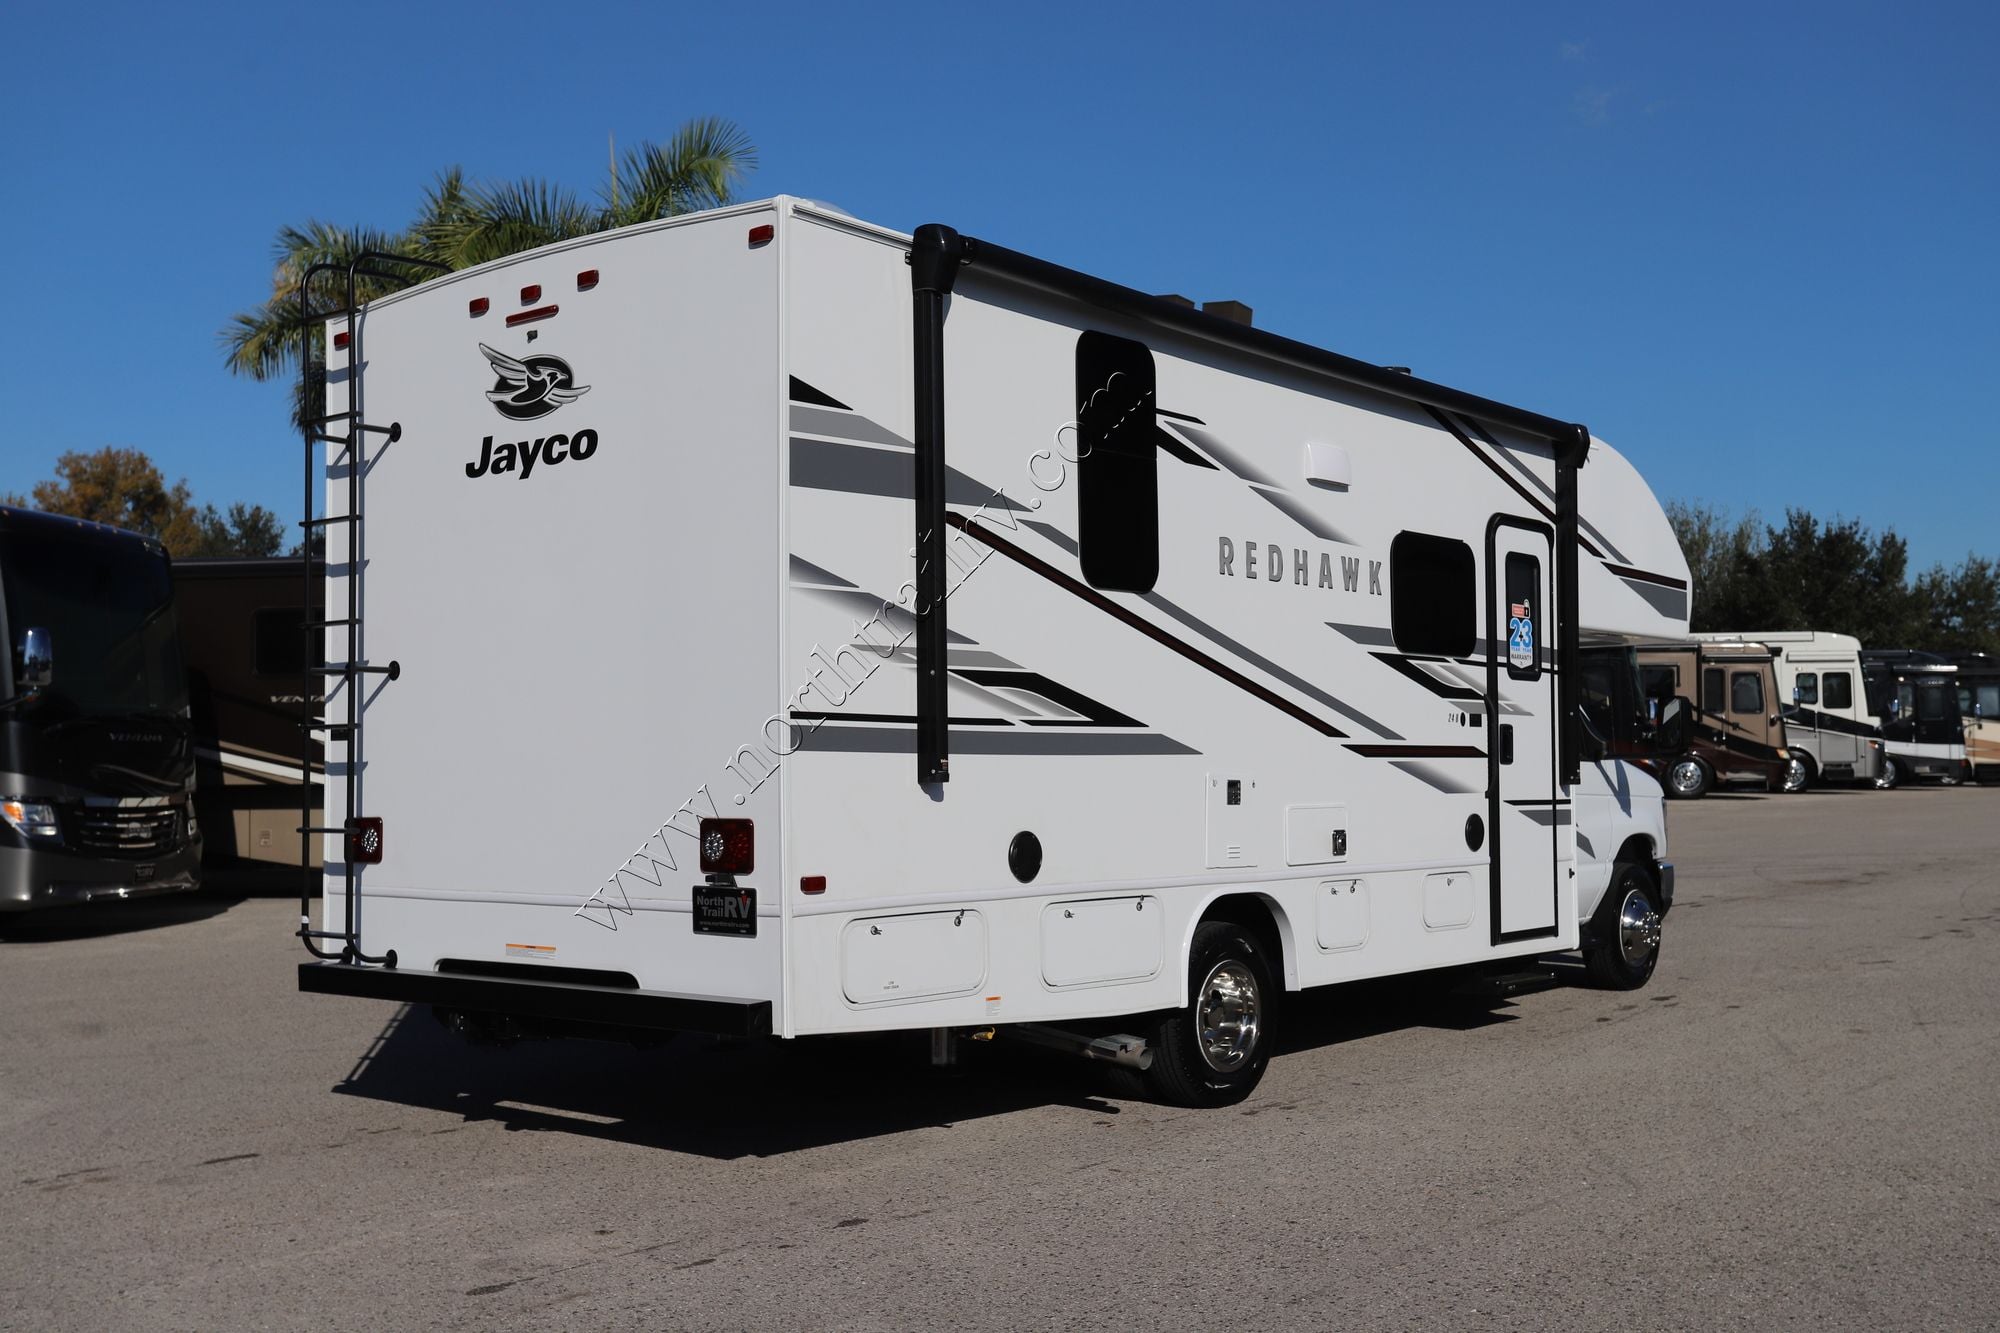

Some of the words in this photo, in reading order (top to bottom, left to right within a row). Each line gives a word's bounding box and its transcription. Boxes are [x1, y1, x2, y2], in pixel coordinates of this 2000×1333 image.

[465, 428, 598, 480] Jayco
[1218, 536, 1382, 596] REDHAWK
[696, 895, 724, 906] North
[724, 895, 752, 918] RV
[701, 906, 724, 918] Trail
